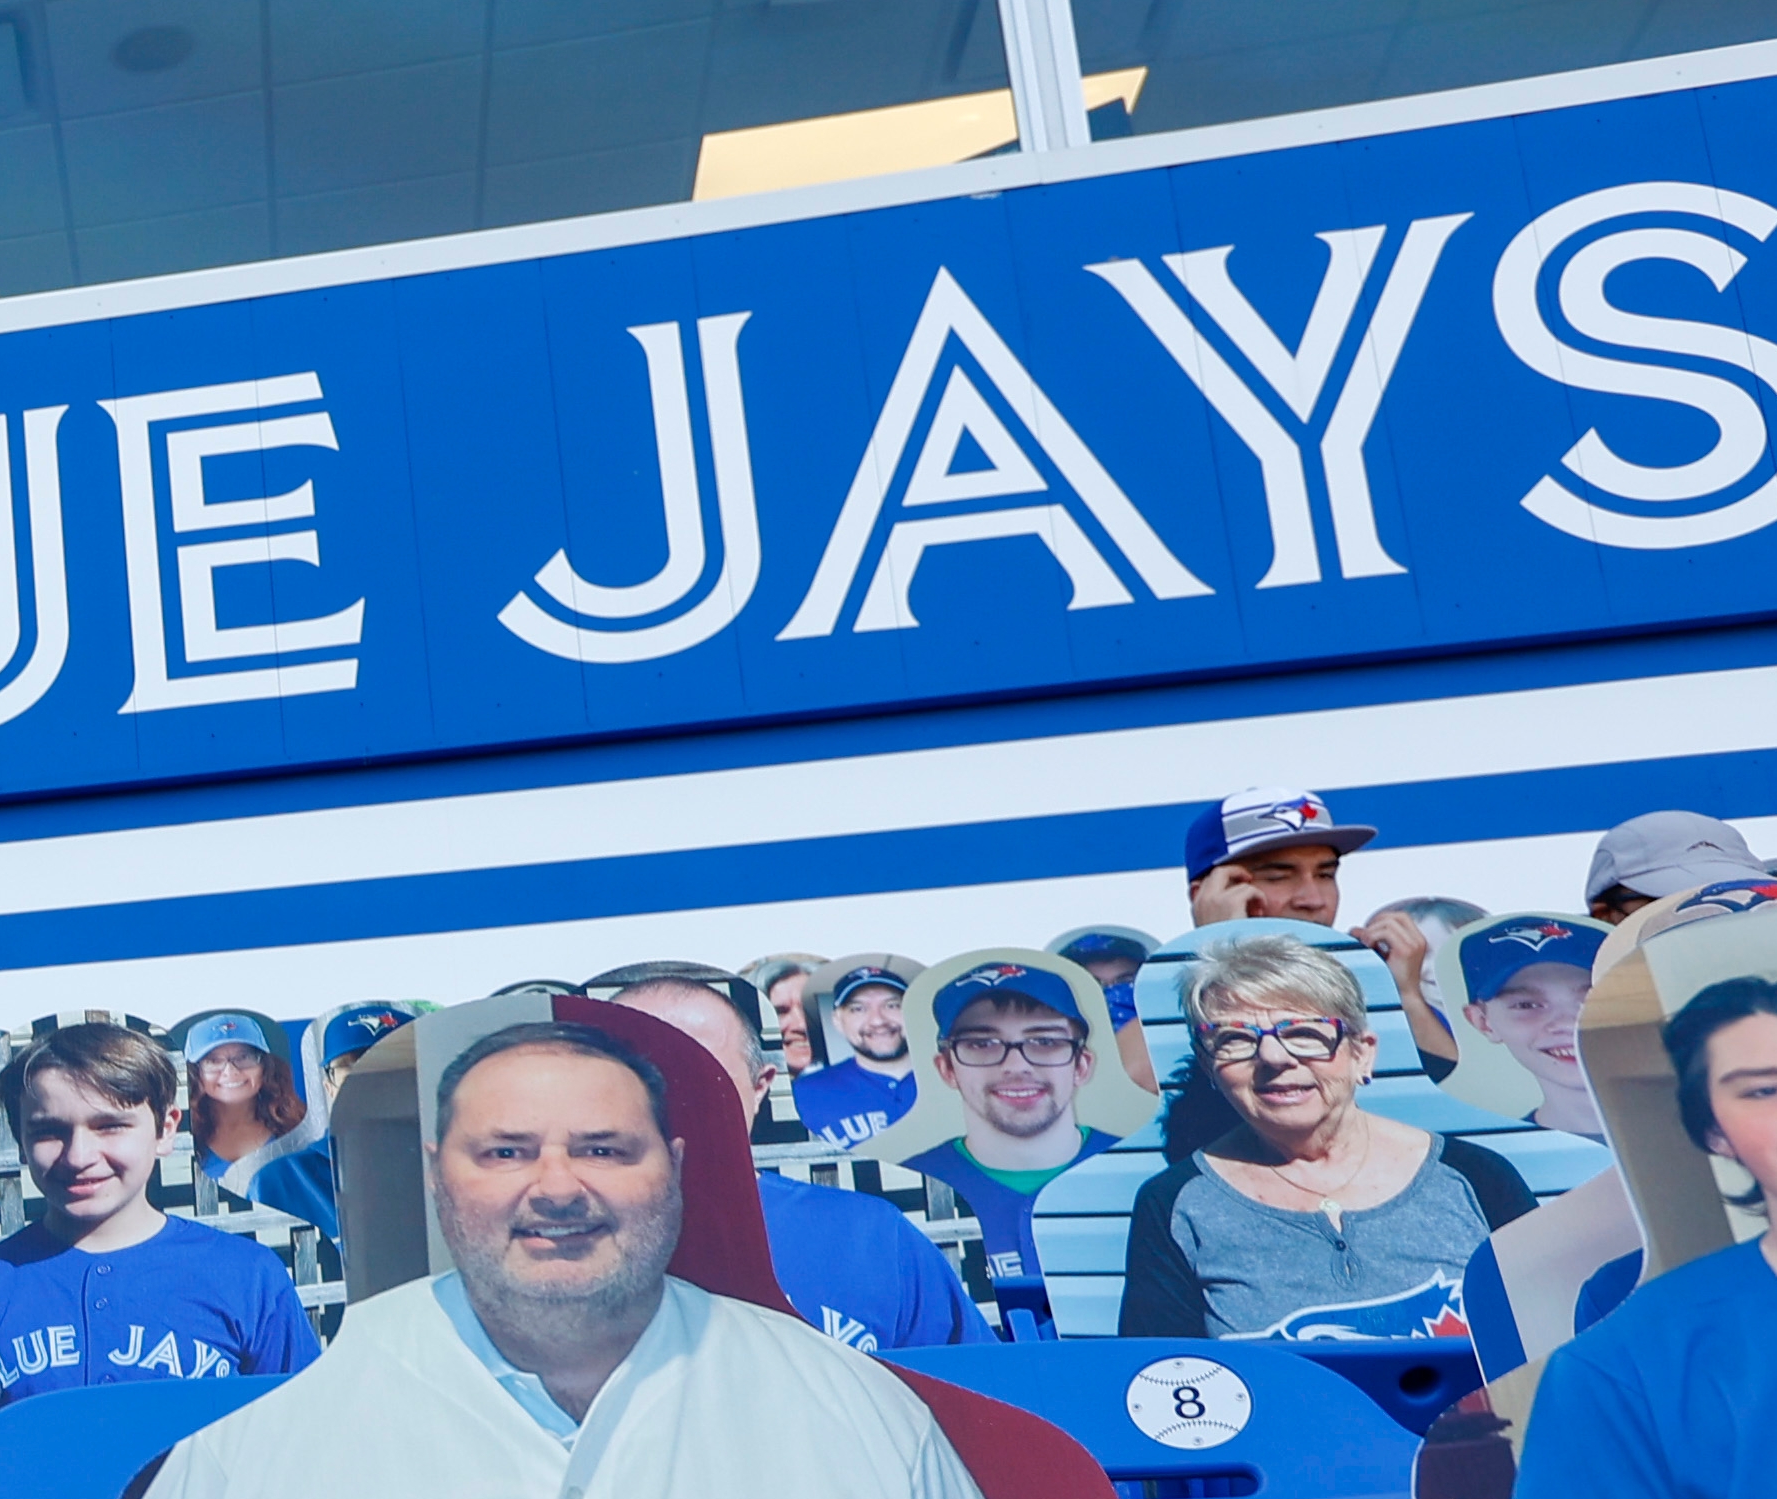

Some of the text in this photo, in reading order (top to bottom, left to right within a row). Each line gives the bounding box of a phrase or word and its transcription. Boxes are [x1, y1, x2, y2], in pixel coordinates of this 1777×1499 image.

[497, 180, 1777, 664] JAYS
[817, 1110, 889, 1149] LUE
[1173, 1386, 1205, 1419] 8
